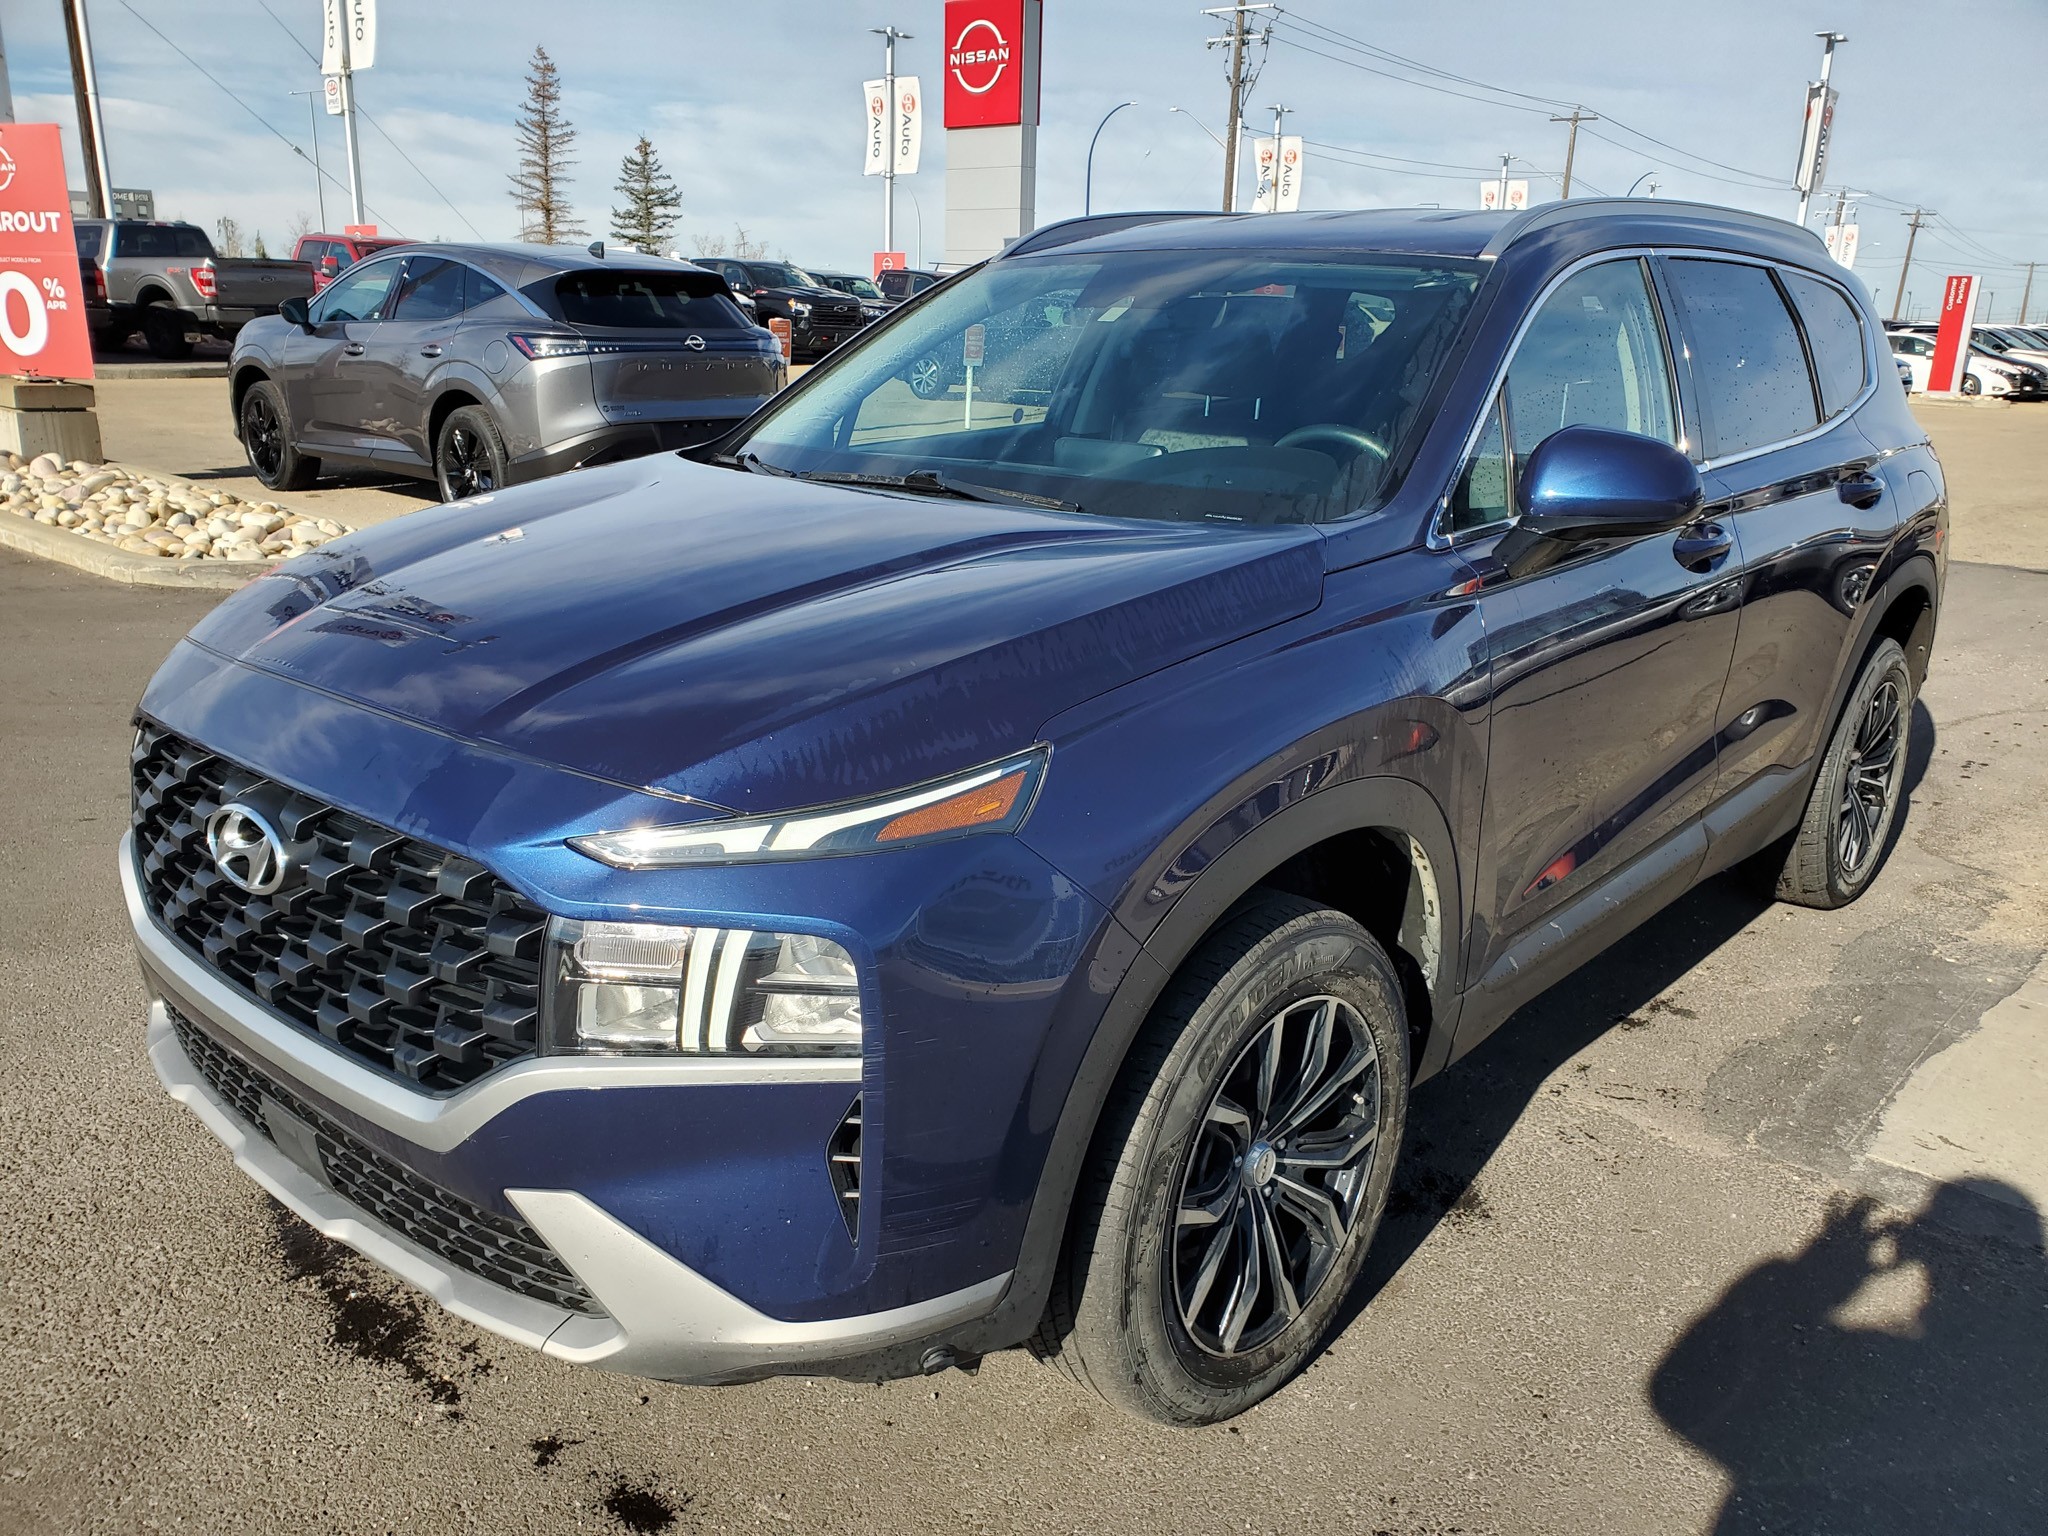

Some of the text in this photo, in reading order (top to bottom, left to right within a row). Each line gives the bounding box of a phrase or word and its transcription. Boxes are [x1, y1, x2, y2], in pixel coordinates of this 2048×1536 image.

[354, 0, 364, 40] uto
[950, 48, 1009, 66] NISSAN
[873, 117, 881, 157] Auto
[902, 114, 911, 156] Auto
[1282, 165, 1292, 197] Auto
[0, 211, 60, 232] ROUT
[46, 300, 67, 310] APR
[1946, 278, 1957, 311] Customer
[1956, 277, 1968, 304] Parking
